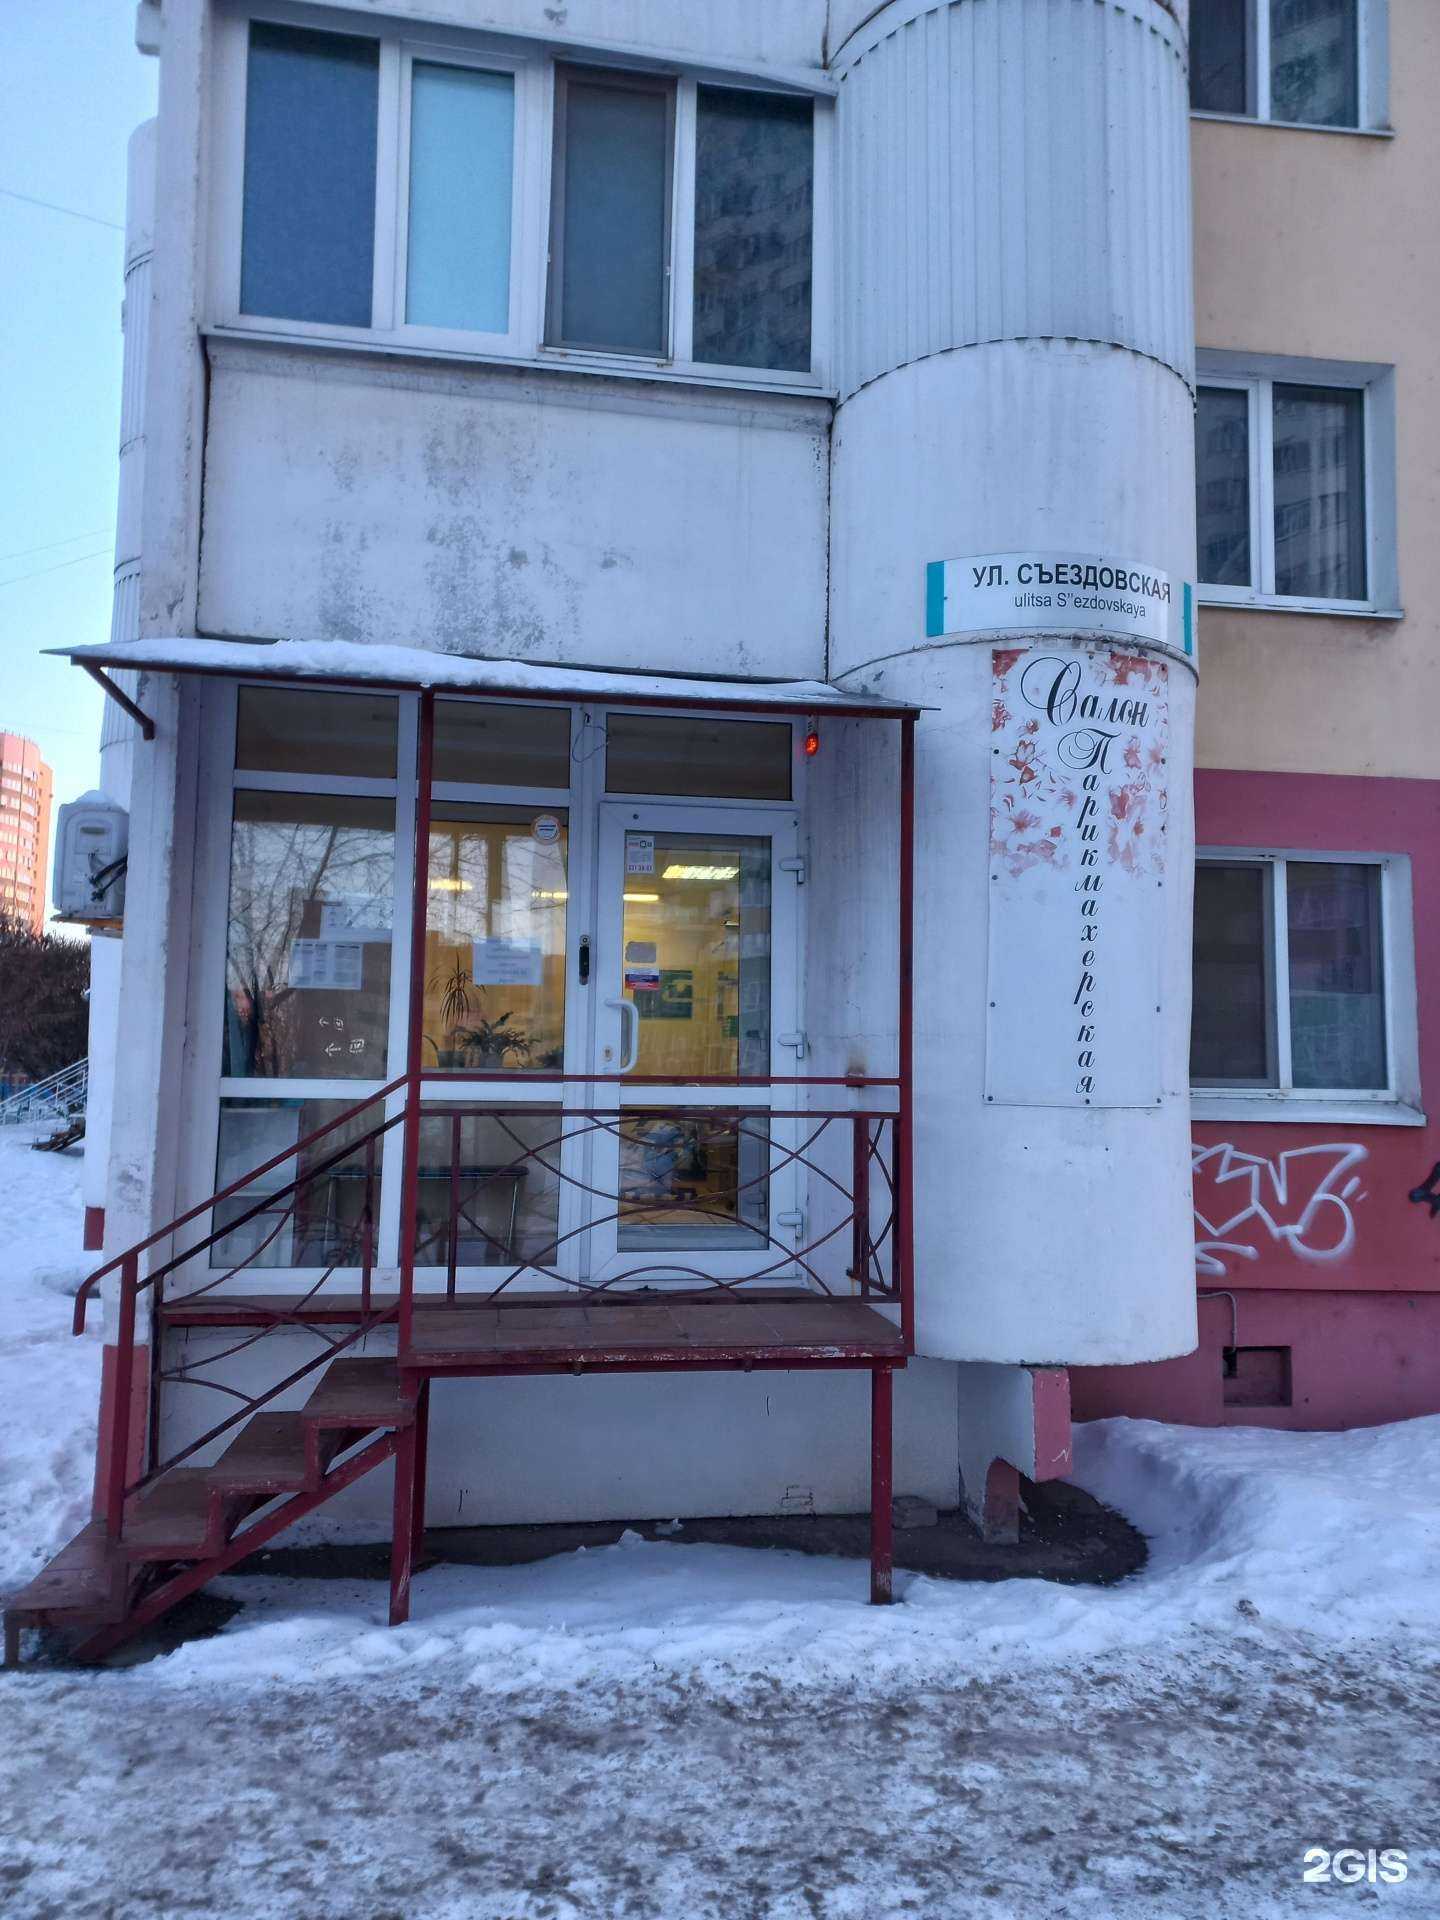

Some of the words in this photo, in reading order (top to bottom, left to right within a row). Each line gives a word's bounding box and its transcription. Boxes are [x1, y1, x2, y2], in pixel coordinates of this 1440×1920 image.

[972, 565, 1009, 588] УЛ.
[1017, 563, 1171, 603] СЪЕЗДОВСКАЯ
[1014, 592, 1052, 608] ulitsa
[1020, 656, 1150, 728] Салон
[1057, 728, 1122, 1094] Парикмахерская
